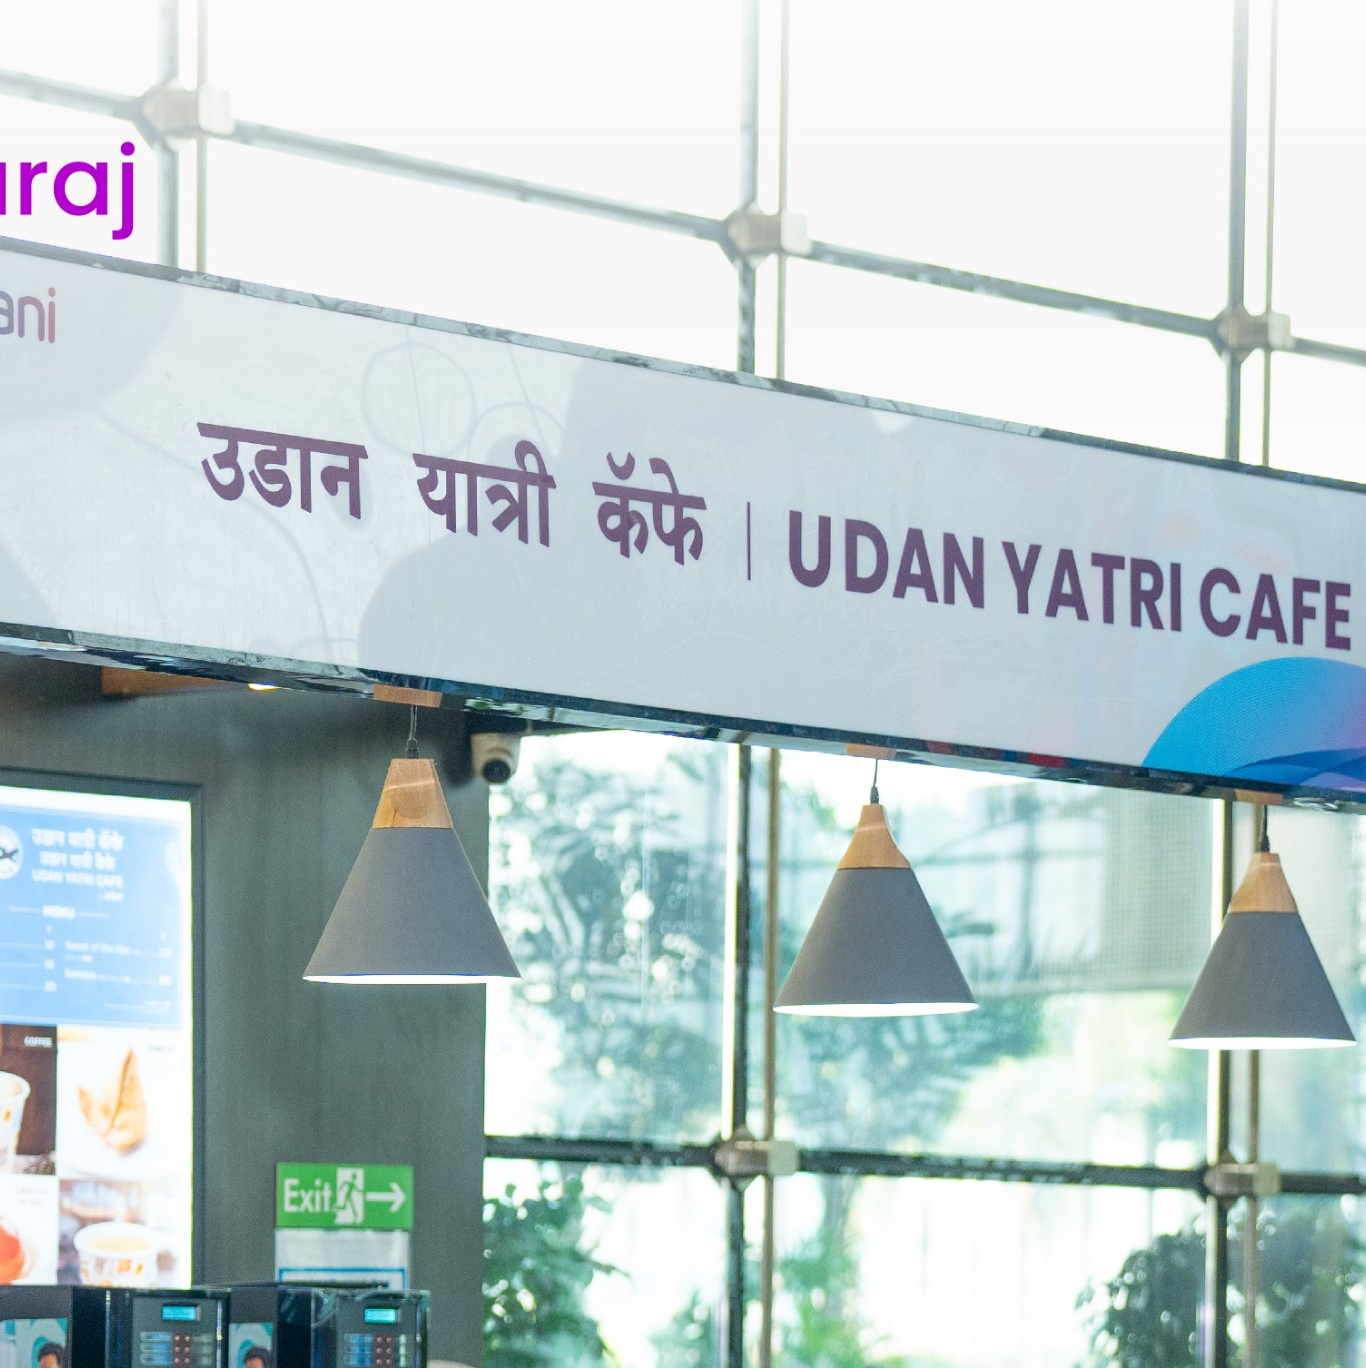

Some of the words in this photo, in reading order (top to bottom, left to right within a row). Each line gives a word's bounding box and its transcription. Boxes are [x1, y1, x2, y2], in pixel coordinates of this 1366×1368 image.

[198, 422, 367, 520] उडान
[412, 440, 555, 547] यात्री
[593, 452, 705, 565] कॅफे
[788, 510, 984, 608] UDAN
[1003, 543, 1183, 632] YATRI
[1199, 567, 1352, 651] CAFE
[283, 1178, 332, 1213] Exit
